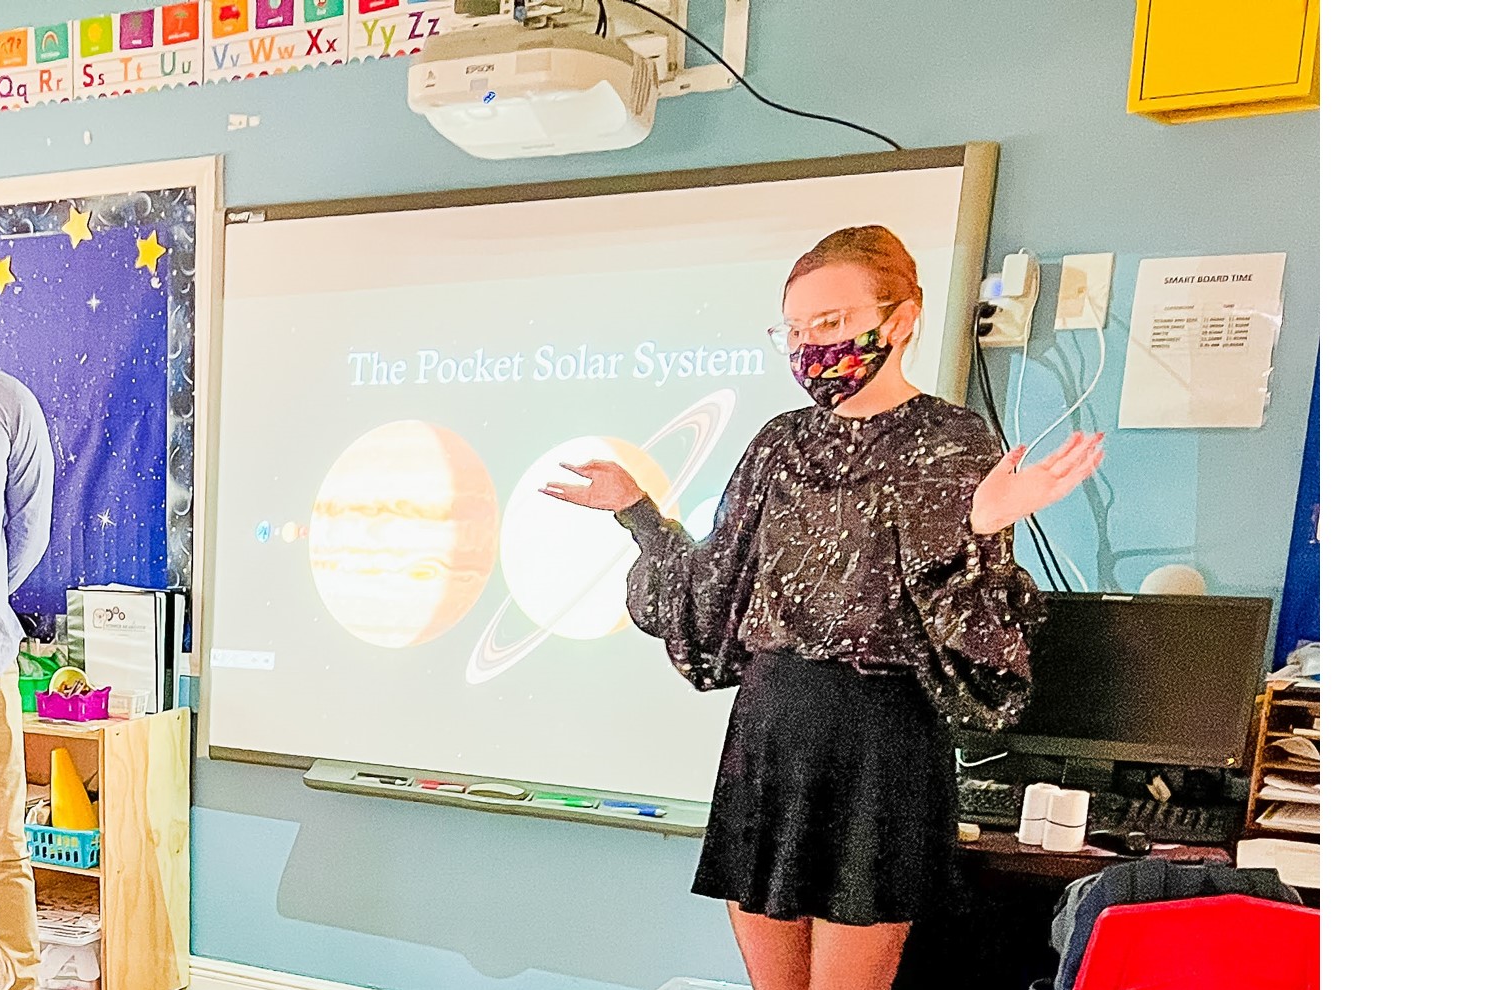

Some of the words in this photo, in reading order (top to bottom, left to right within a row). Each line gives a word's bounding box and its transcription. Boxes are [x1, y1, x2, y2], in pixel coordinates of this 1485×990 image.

[39, 69, 63, 93] Rr
[82, 64, 105, 87] Ss
[120, 57, 143, 81] Tt
[161, 51, 191, 77] Uu
[212, 43, 240, 70] Vv
[249, 36, 295, 64] Ww
[306, 28, 338, 56] Xx
[362, 19, 396, 54] Yy
[408, 11, 440, 40] Zz
[1164, 276, 1195, 285] SMART
[1197, 275, 1229, 283] BOARD
[1232, 274, 1253, 282] TIME
[347, 350, 407, 386] The
[414, 348, 523, 385] Pocket
[532, 343, 622, 382] Solar
[633, 340, 766, 387] System
